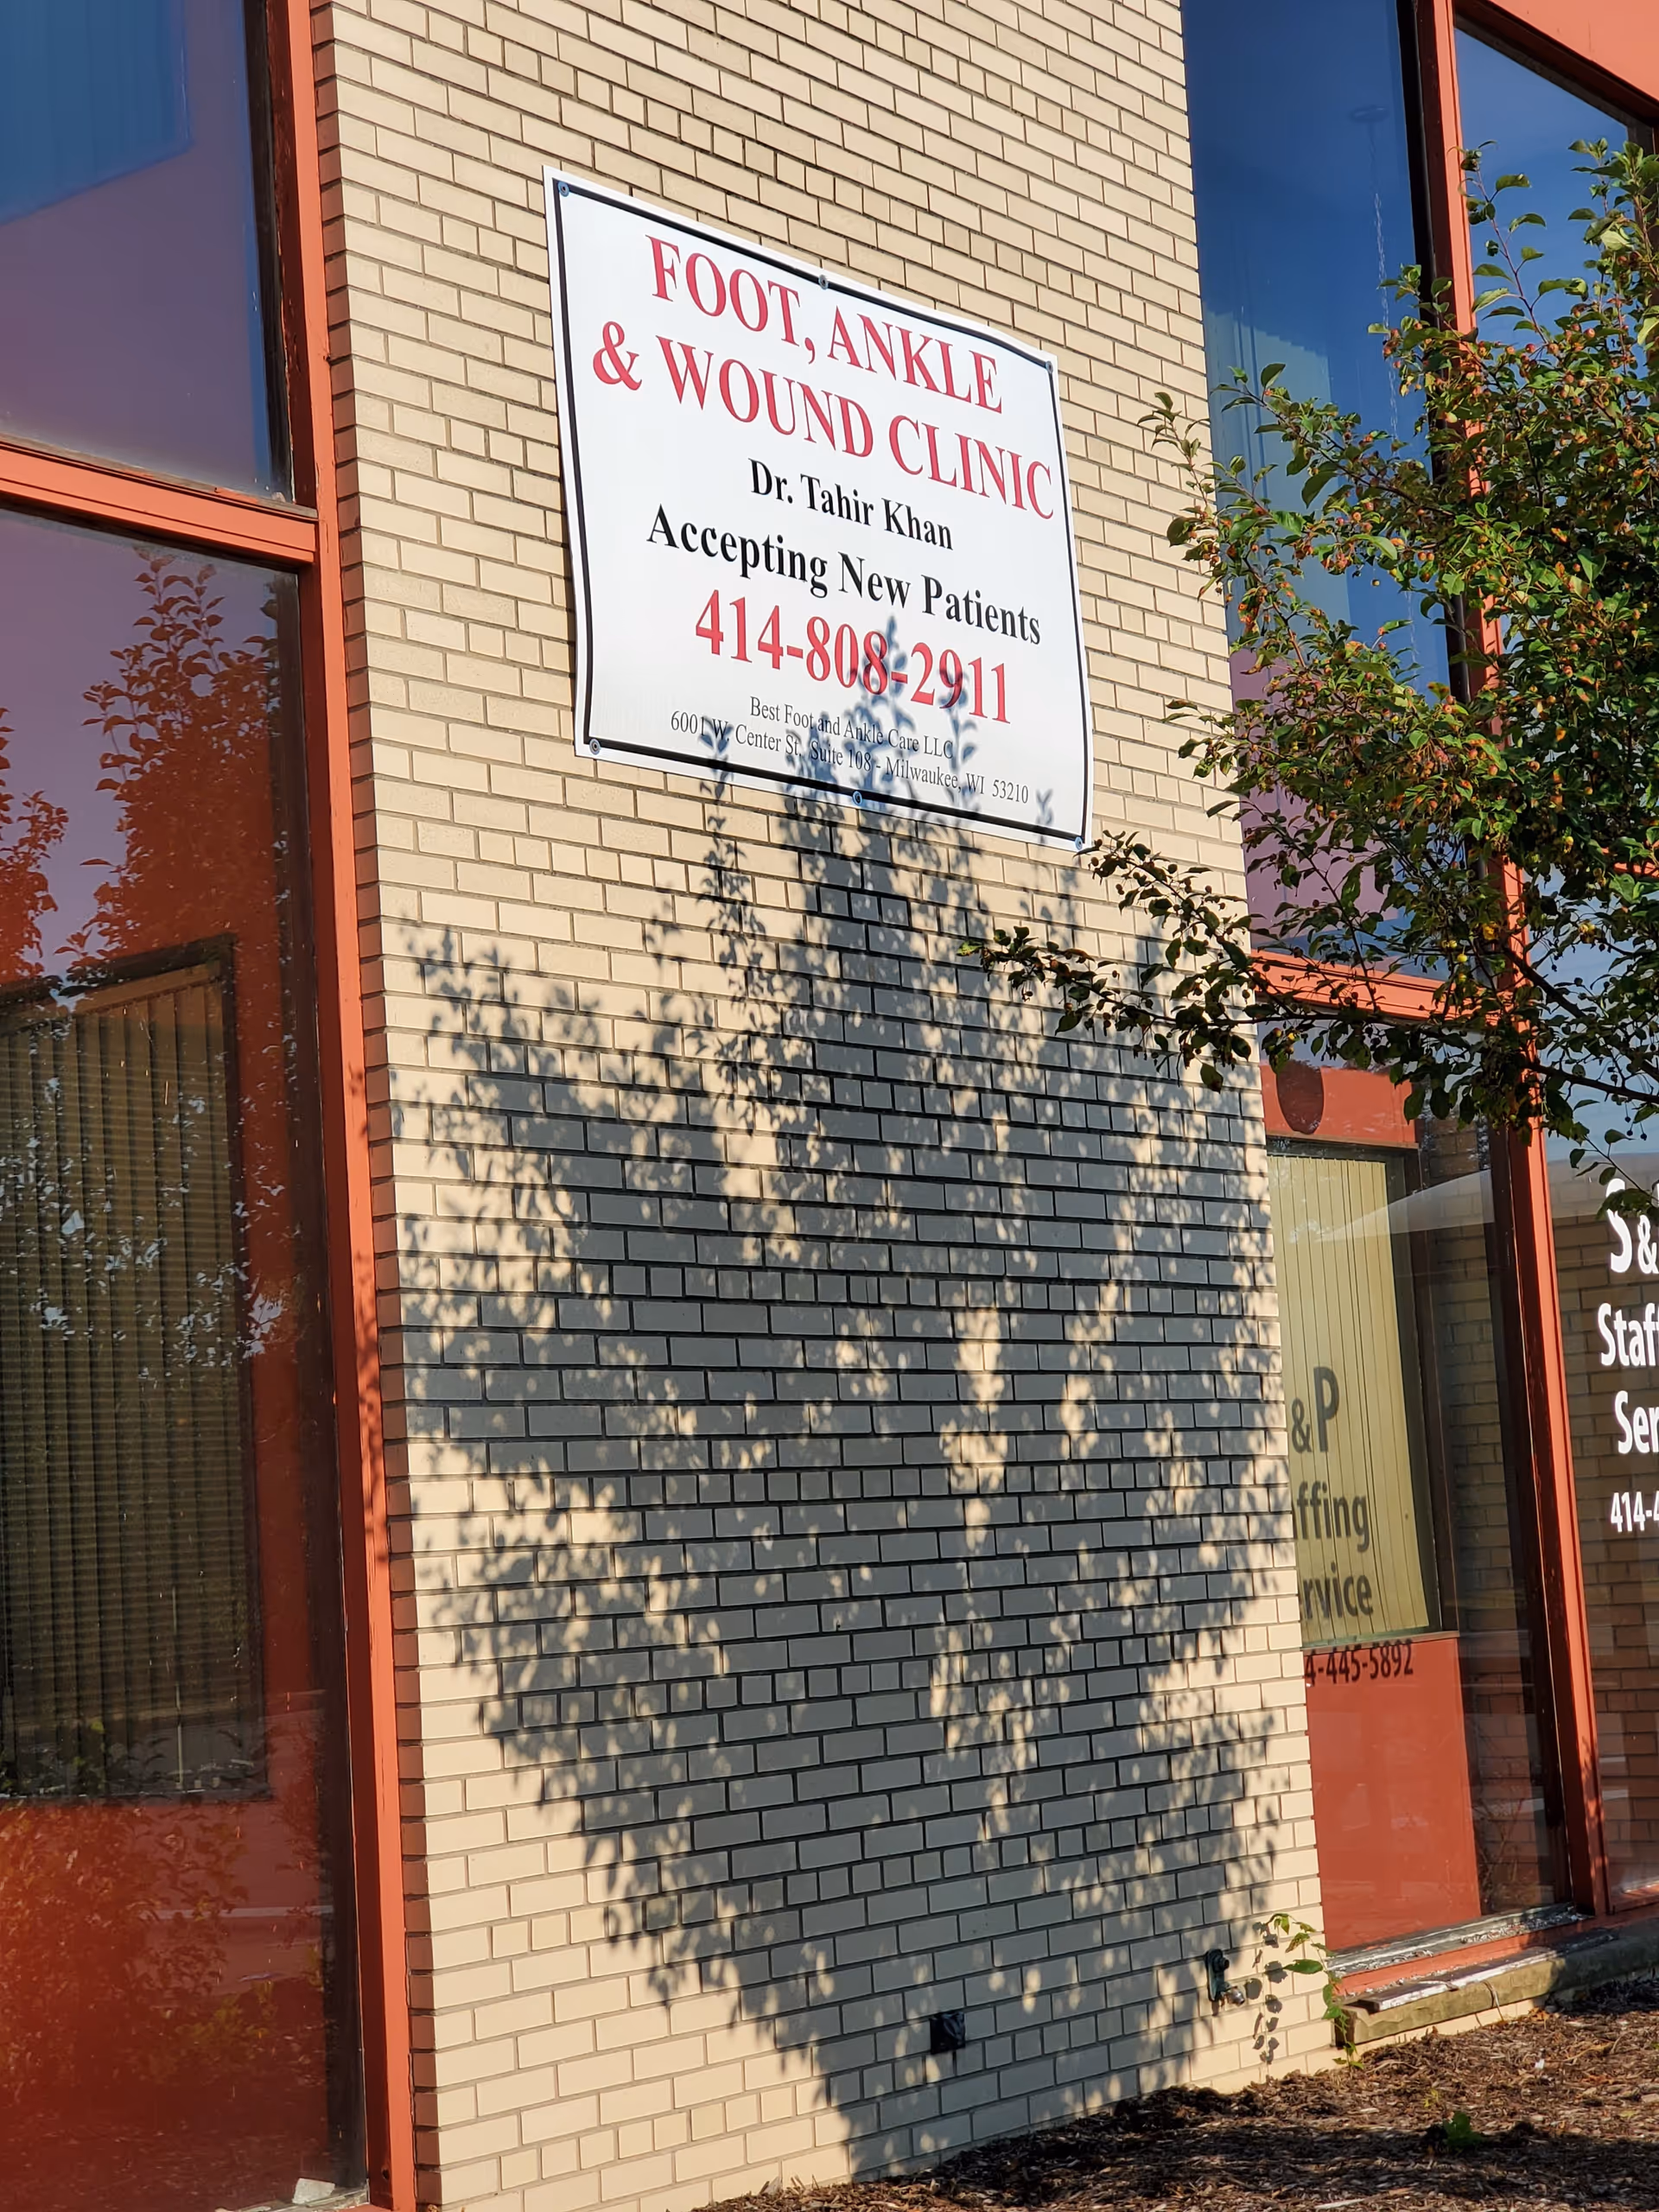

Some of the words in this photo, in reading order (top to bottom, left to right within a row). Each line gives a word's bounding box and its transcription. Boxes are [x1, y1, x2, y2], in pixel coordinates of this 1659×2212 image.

[645, 234, 816, 365] FOOT,
[827, 305, 1002, 414] ANKLE
[593, 321, 643, 391] &
[656, 335, 874, 458] WOUND
[889, 415, 1054, 519] CLINIC
[748, 458, 793, 505] Dr.
[800, 474, 874, 526] Tahir
[881, 498, 953, 550] Khan
[646, 503, 828, 599] Accepting
[837, 551, 911, 609] New
[921, 574, 1040, 645] Patients
[696, 589, 1011, 725] 414-808-2911
[671, 711, 706, 736] 6001
[712, 718, 730, 741] W.
[735, 724, 781, 752] Center
[785, 734, 802, 757] St.
[810, 741, 843, 766] Suite
[848, 749, 871, 772] 108
[886, 756, 962, 793] Milwaukee,
[965, 772, 986, 795] WI
[992, 779, 1029, 804] 53210
[750, 696, 780, 721] Best
[785, 704, 814, 729] Foot
[817, 717, 841, 735] and
[843, 721, 883, 745] Ankle
[887, 728, 919, 752] Care
[924, 735, 954, 760] LLC
[1598, 1302, 1659, 1366] Staf
[1294, 1481, 1370, 1554] ffing
[1300, 1562, 1375, 1621] rvice
